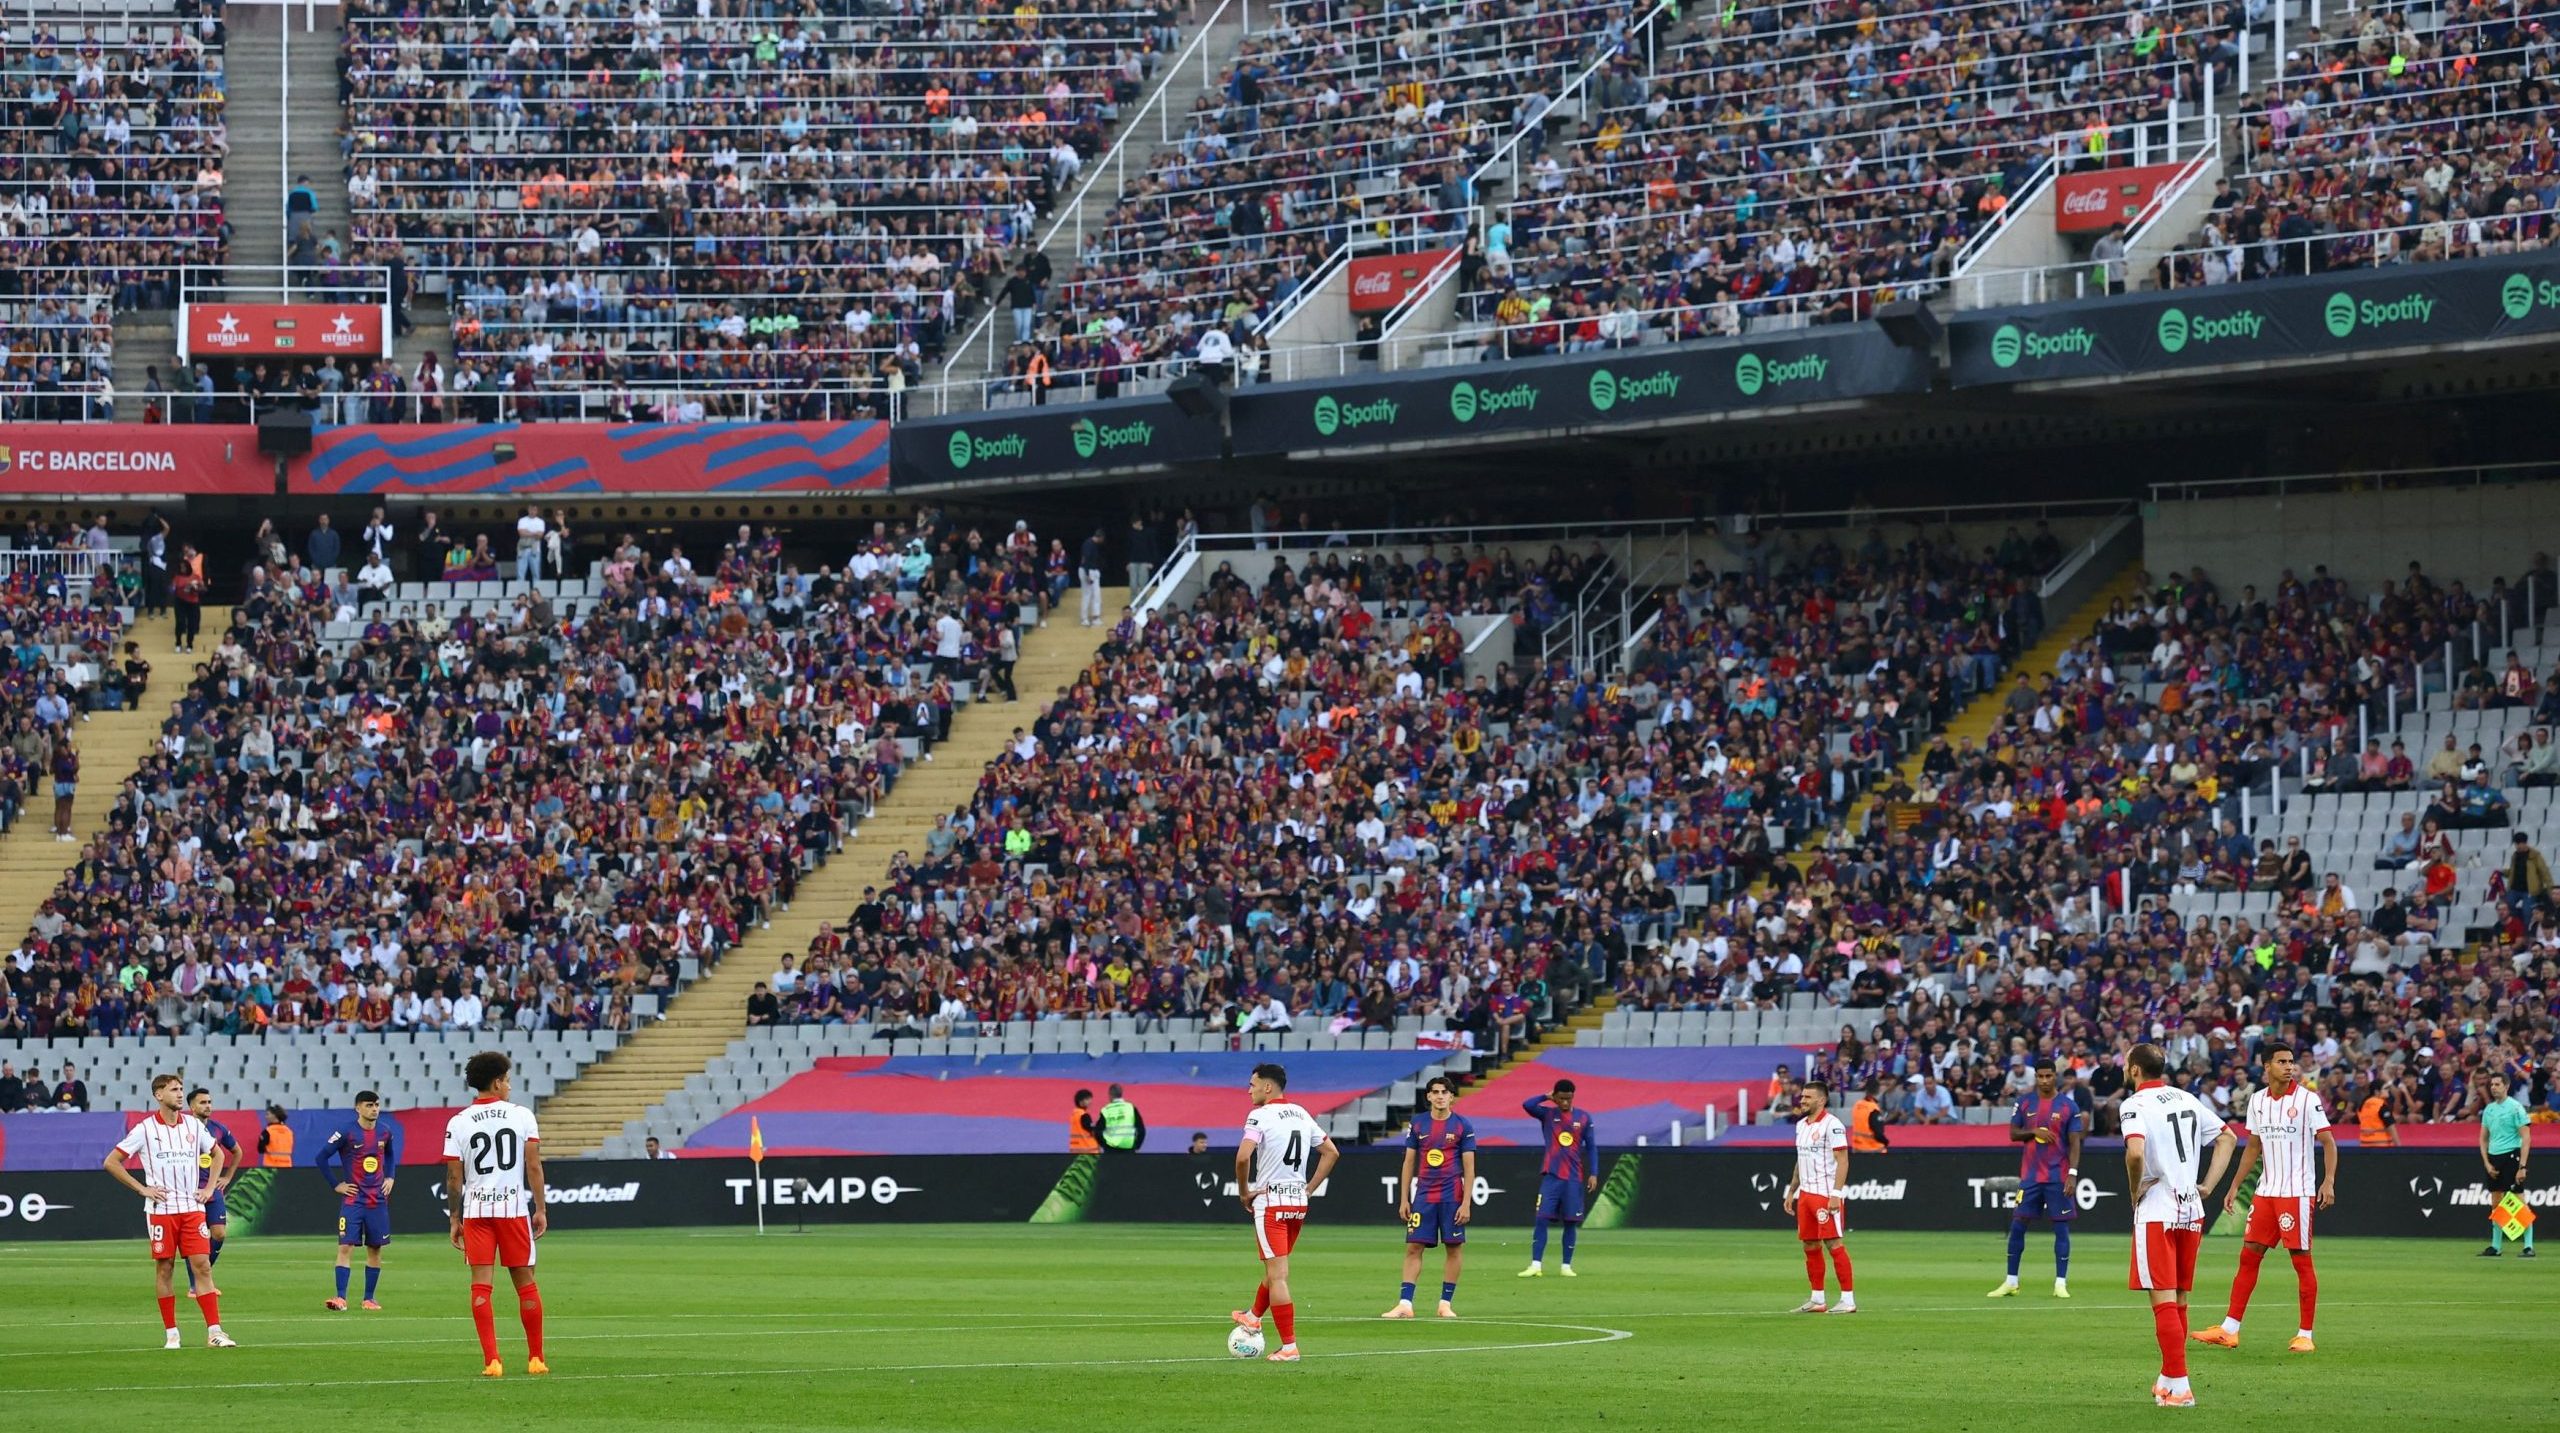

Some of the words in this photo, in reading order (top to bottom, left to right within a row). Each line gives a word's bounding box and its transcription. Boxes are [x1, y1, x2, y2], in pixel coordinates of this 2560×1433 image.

[2360, 293, 2433, 328] Spotify
[2192, 310, 2263, 344] Spotify
[2025, 327, 2094, 359] Spotify
[1766, 353, 1828, 385] Spotify
[1480, 383, 1538, 414] Spotify
[1619, 370, 1680, 401] Spotify
[1342, 397, 1398, 428] Spotify
[974, 433, 1026, 461] Spotify
[1100, 421, 1152, 449] Spotify
[19, 451, 44, 471] FC
[49, 451, 176, 471] BARCELONA
[471, 1109, 508, 1123] WITSEL
[469, 1127, 517, 1176] 20
[1282, 1129, 1302, 1172] 4
[2166, 1109, 2198, 1163] 17
[473, 1189, 510, 1202] Marlex
[725, 1175, 924, 1205] TIEMPO
[338, 1216, 346, 1231] 8
